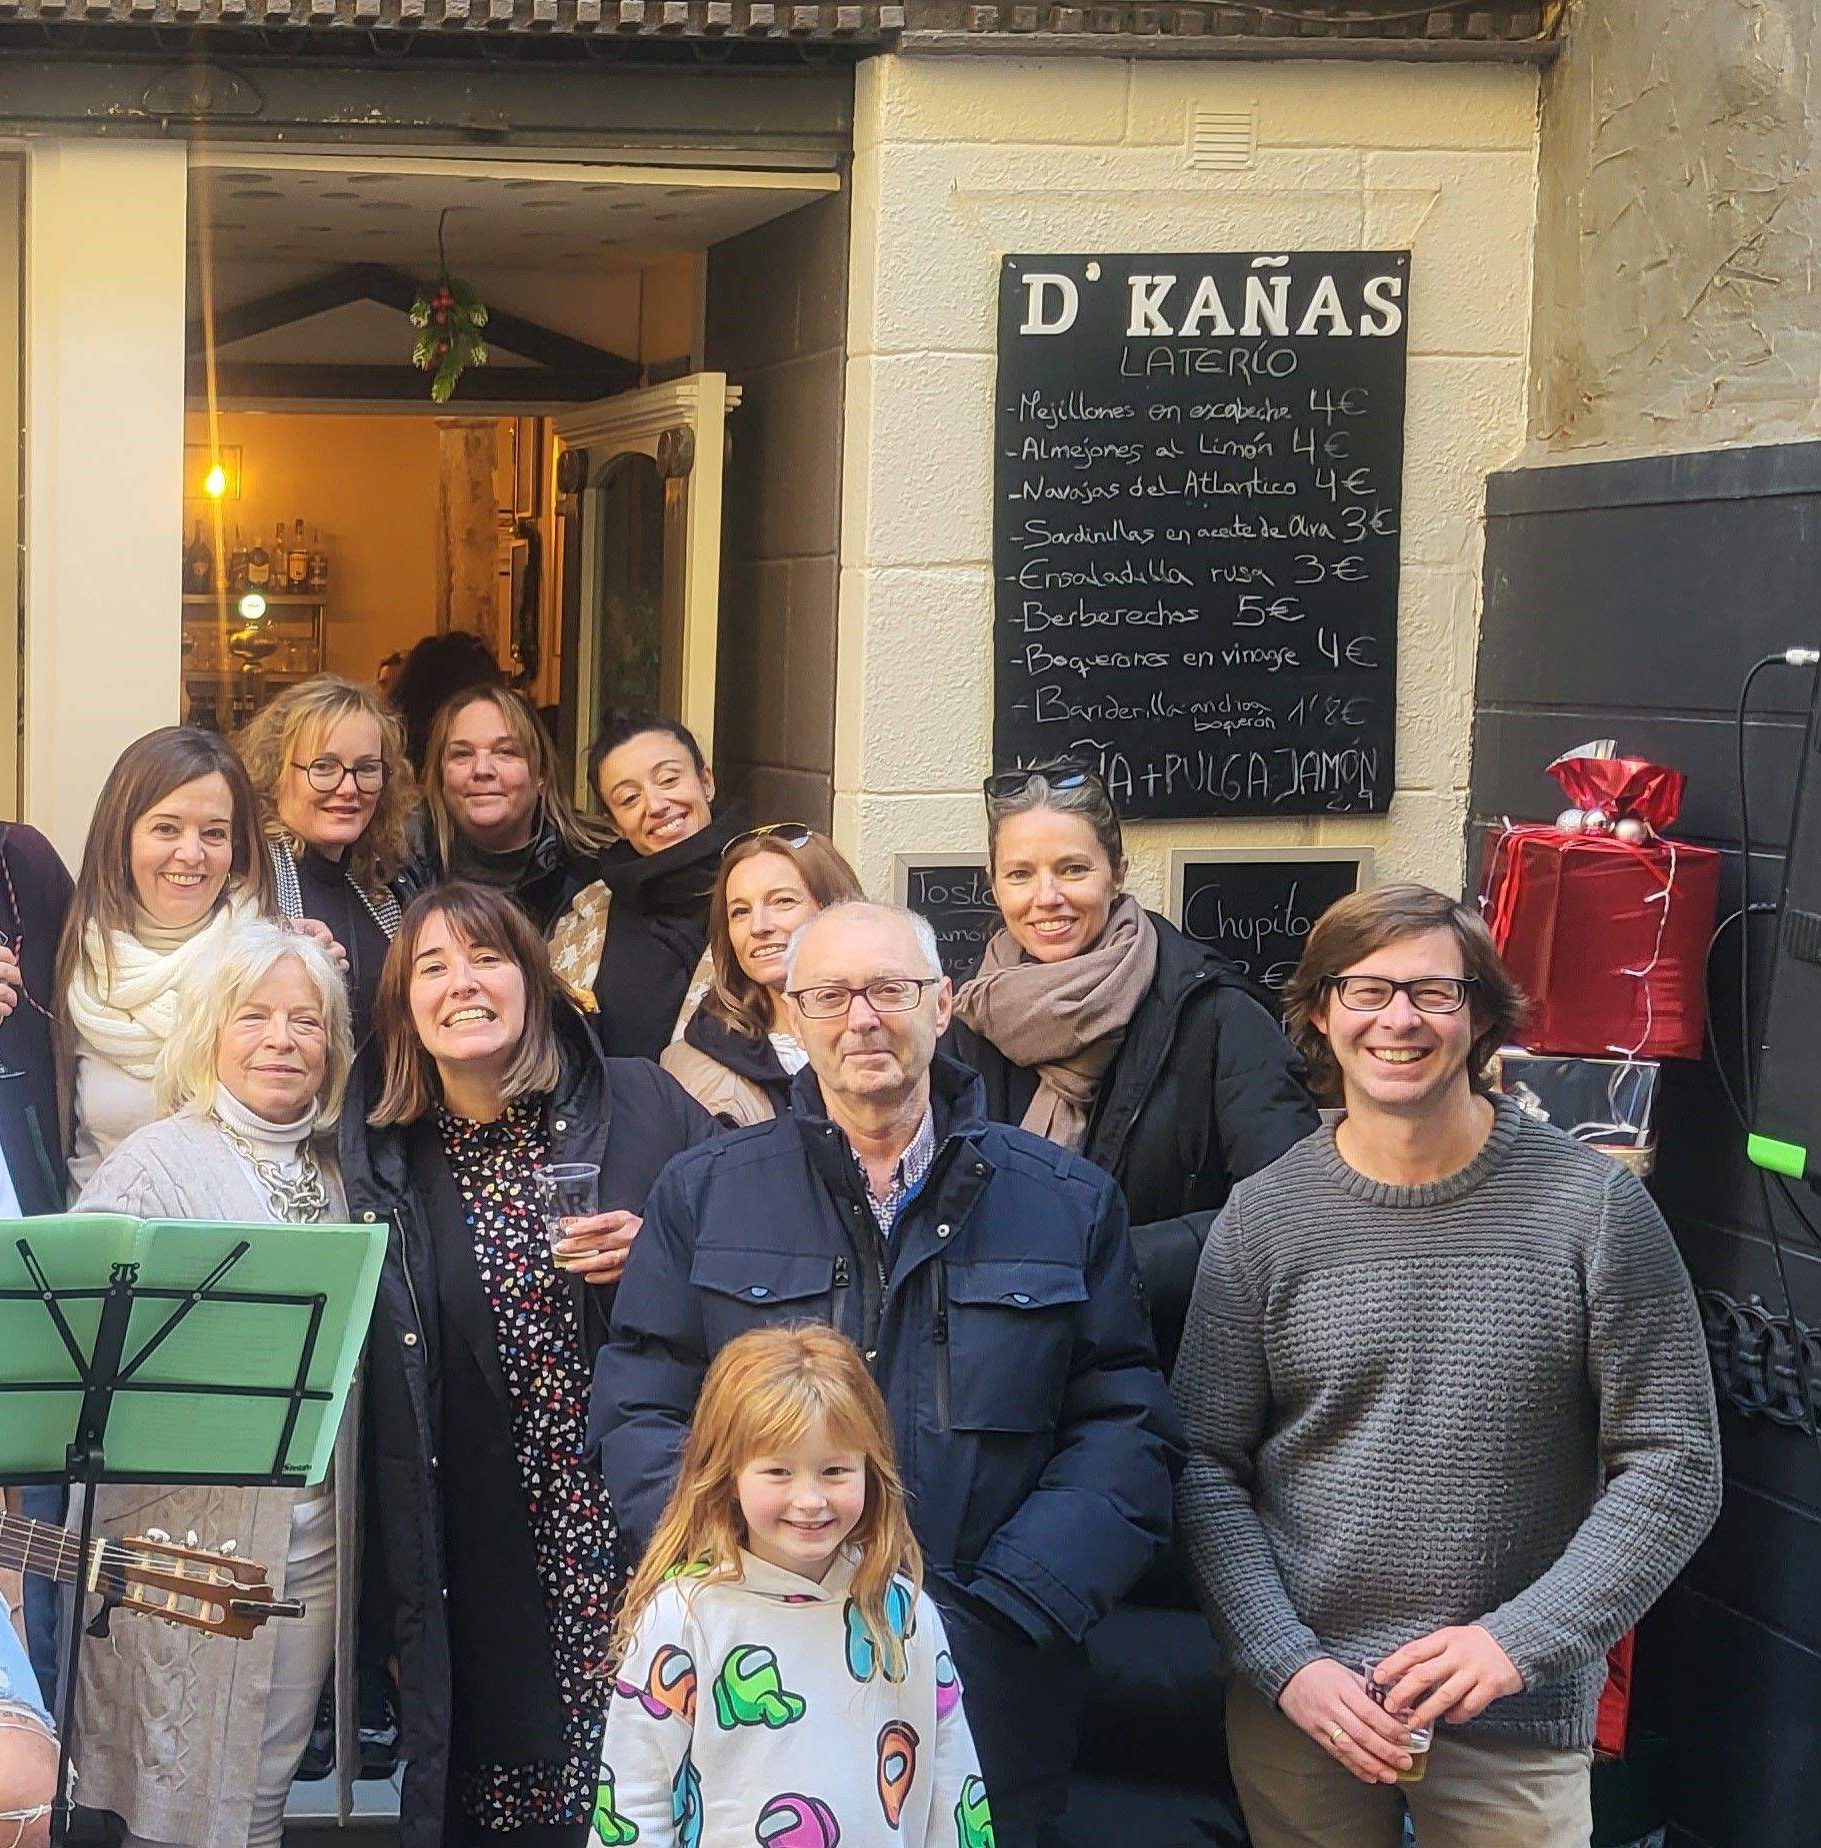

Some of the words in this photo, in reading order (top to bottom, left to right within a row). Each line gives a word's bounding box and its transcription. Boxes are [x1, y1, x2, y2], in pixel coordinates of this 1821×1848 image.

[1020, 261, 1101, 336] D'
[1126, 255, 1403, 337] KAÑAS
[1149, 403, 1180, 423] en
[1310, 386, 1368, 426] 4€
[1156, 438, 1184, 459] al
[1199, 431, 1273, 460] Limón
[1292, 427, 1350, 466] 4€
[1129, 475, 1180, 496] del
[1184, 467, 1296, 499] Atlantico
[1315, 468, 1376, 502] 4€
[1166, 528, 1191, 545] en
[1259, 516, 1287, 538] de
[1341, 506, 1398, 544] 3€
[1211, 565, 1275, 587] rusa
[1294, 554, 1369, 585] 3€
[1232, 593, 1306, 627] 5€
[1183, 651, 1214, 668] en
[1222, 642, 1301, 672] vinagre
[1318, 627, 1378, 668] 4€
[1271, 737, 1378, 804] JAMÓN
